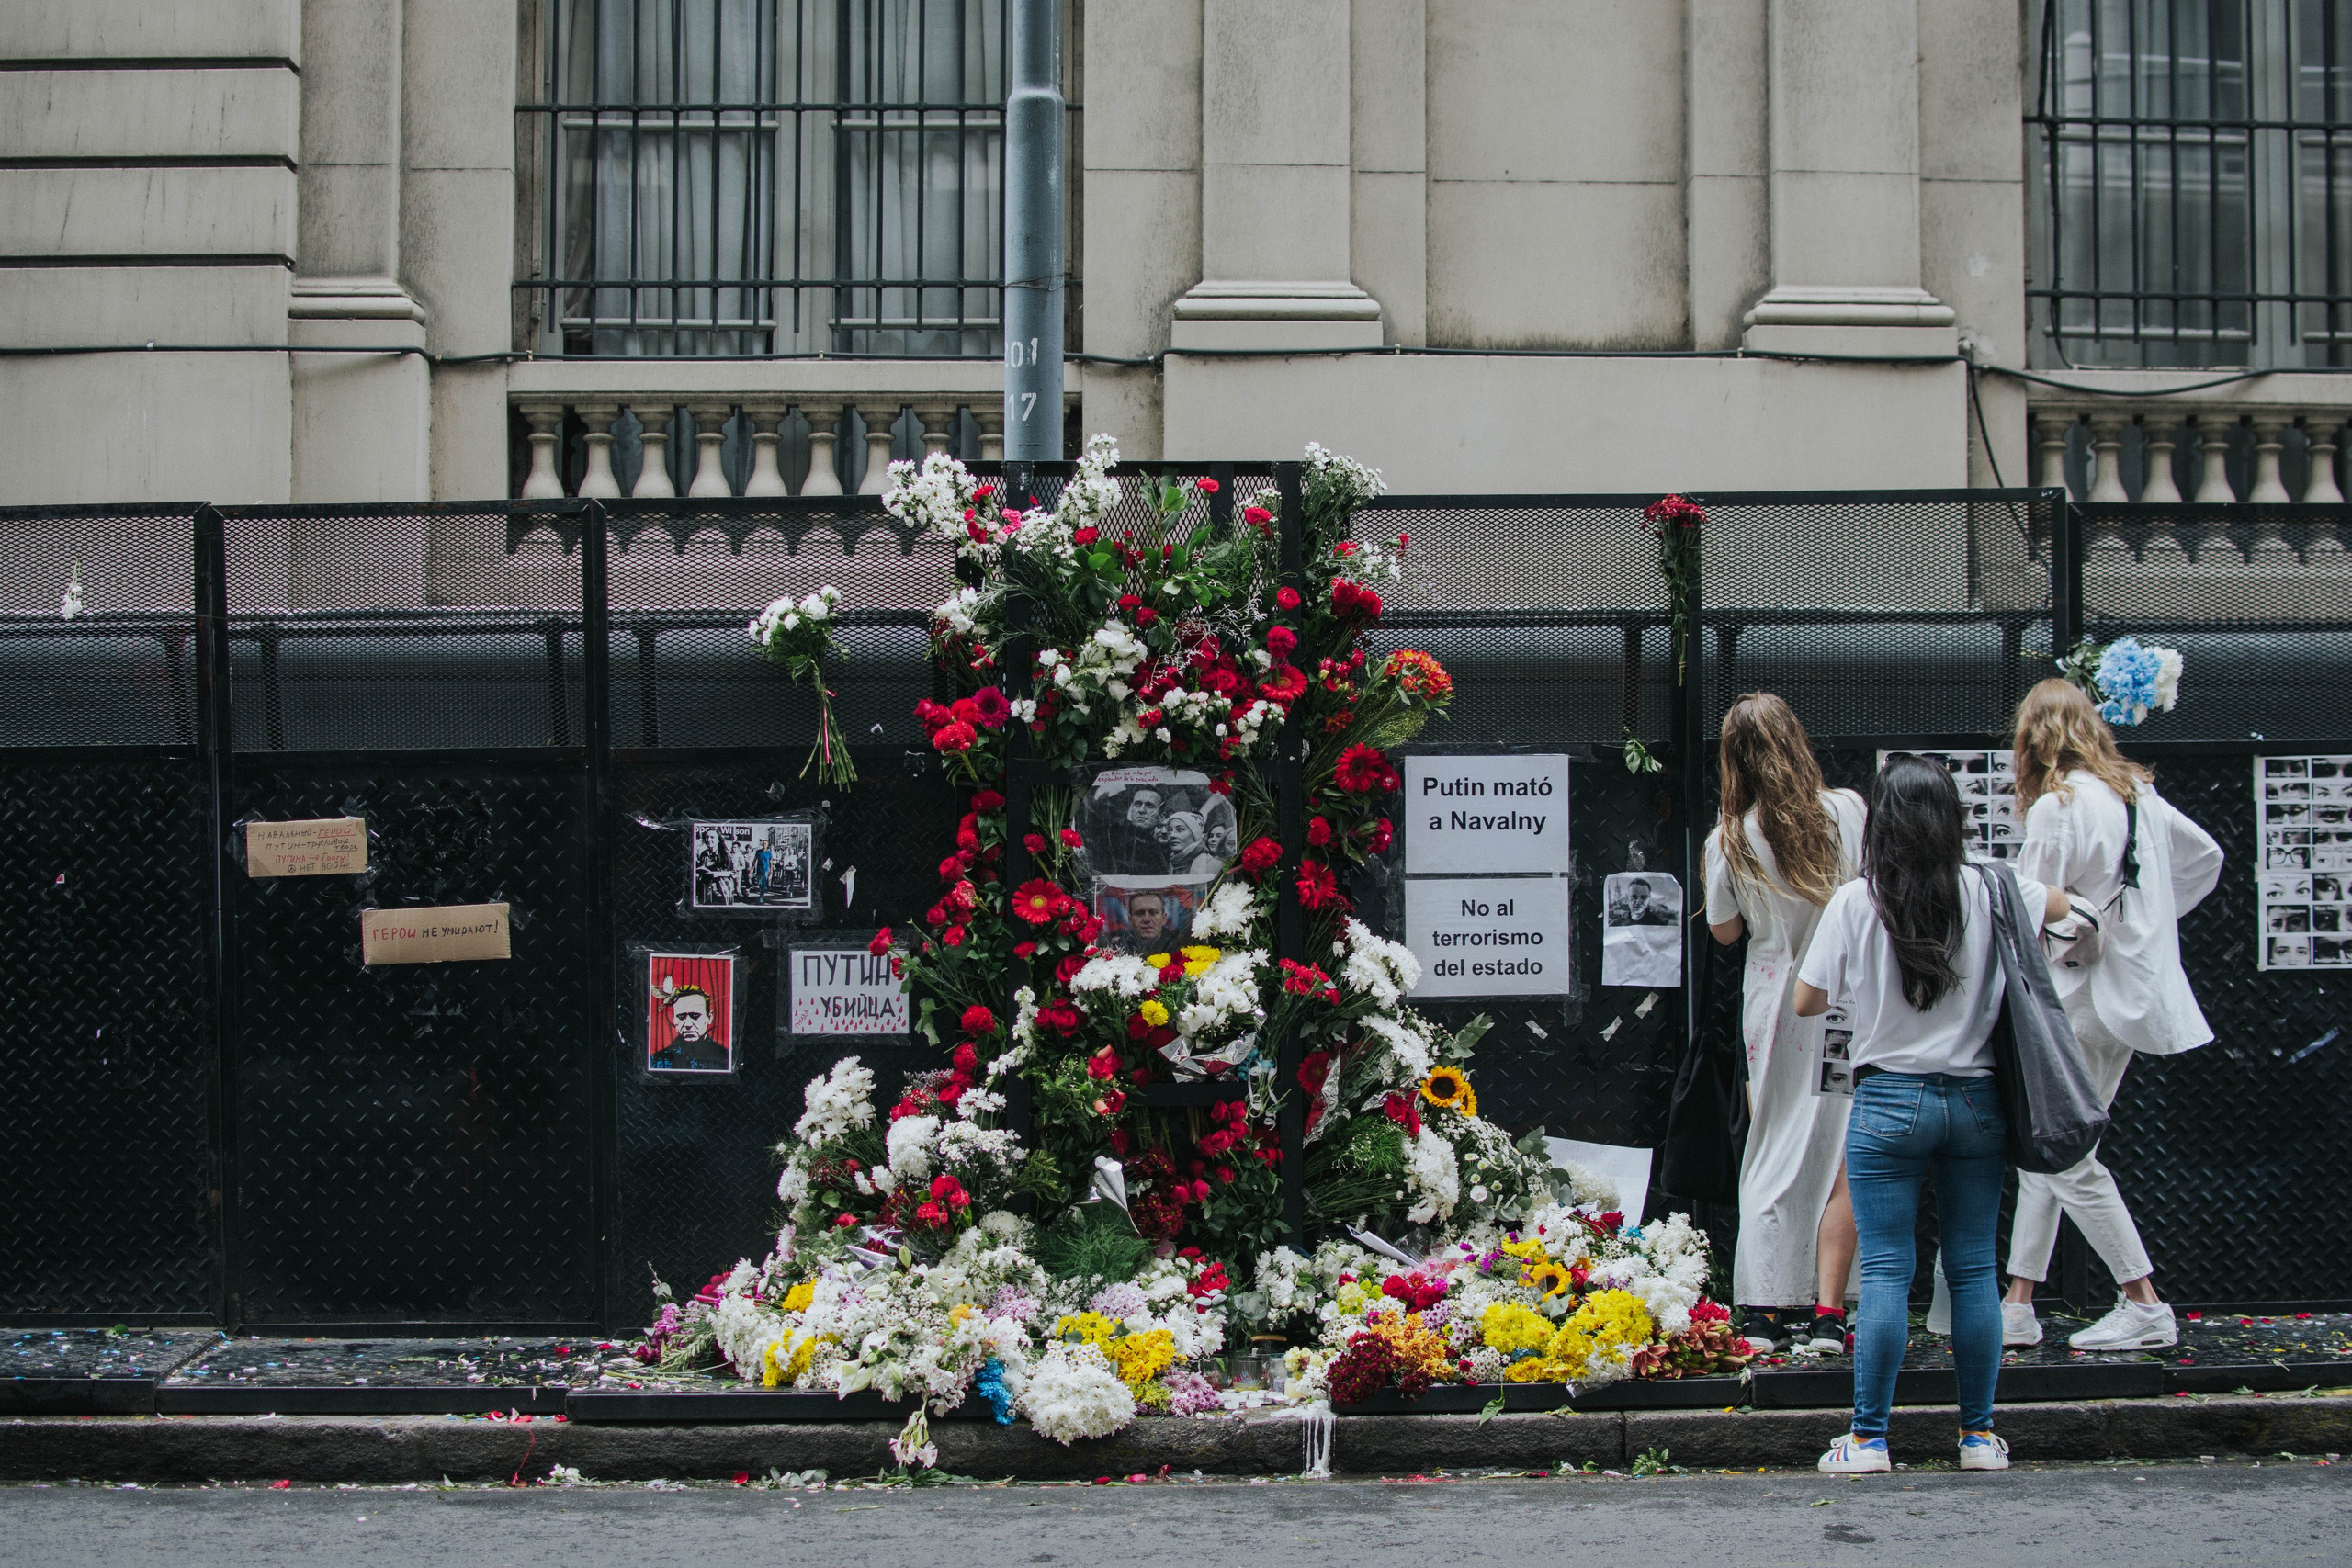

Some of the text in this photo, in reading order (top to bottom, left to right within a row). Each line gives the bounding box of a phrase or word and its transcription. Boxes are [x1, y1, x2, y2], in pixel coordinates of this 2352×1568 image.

[1005, 337, 1038, 367] 01
[1008, 392, 1037, 422] 17
[1423, 776, 1553, 796] Putin mató
[1429, 811, 1546, 835] a Navalny
[276, 854, 306, 863] ПУТИНА
[300, 863, 316, 872] НЕТ
[1462, 899, 1514, 916] No al
[372, 919, 499, 941] ГЕРОИ НЕ УМИРАЮТ!
[1432, 929, 1544, 946] terrorismo
[803, 953, 892, 987] ПУТИН
[1433, 958, 1543, 976] del estado
[820, 993, 896, 1020] УБИЙЦА
